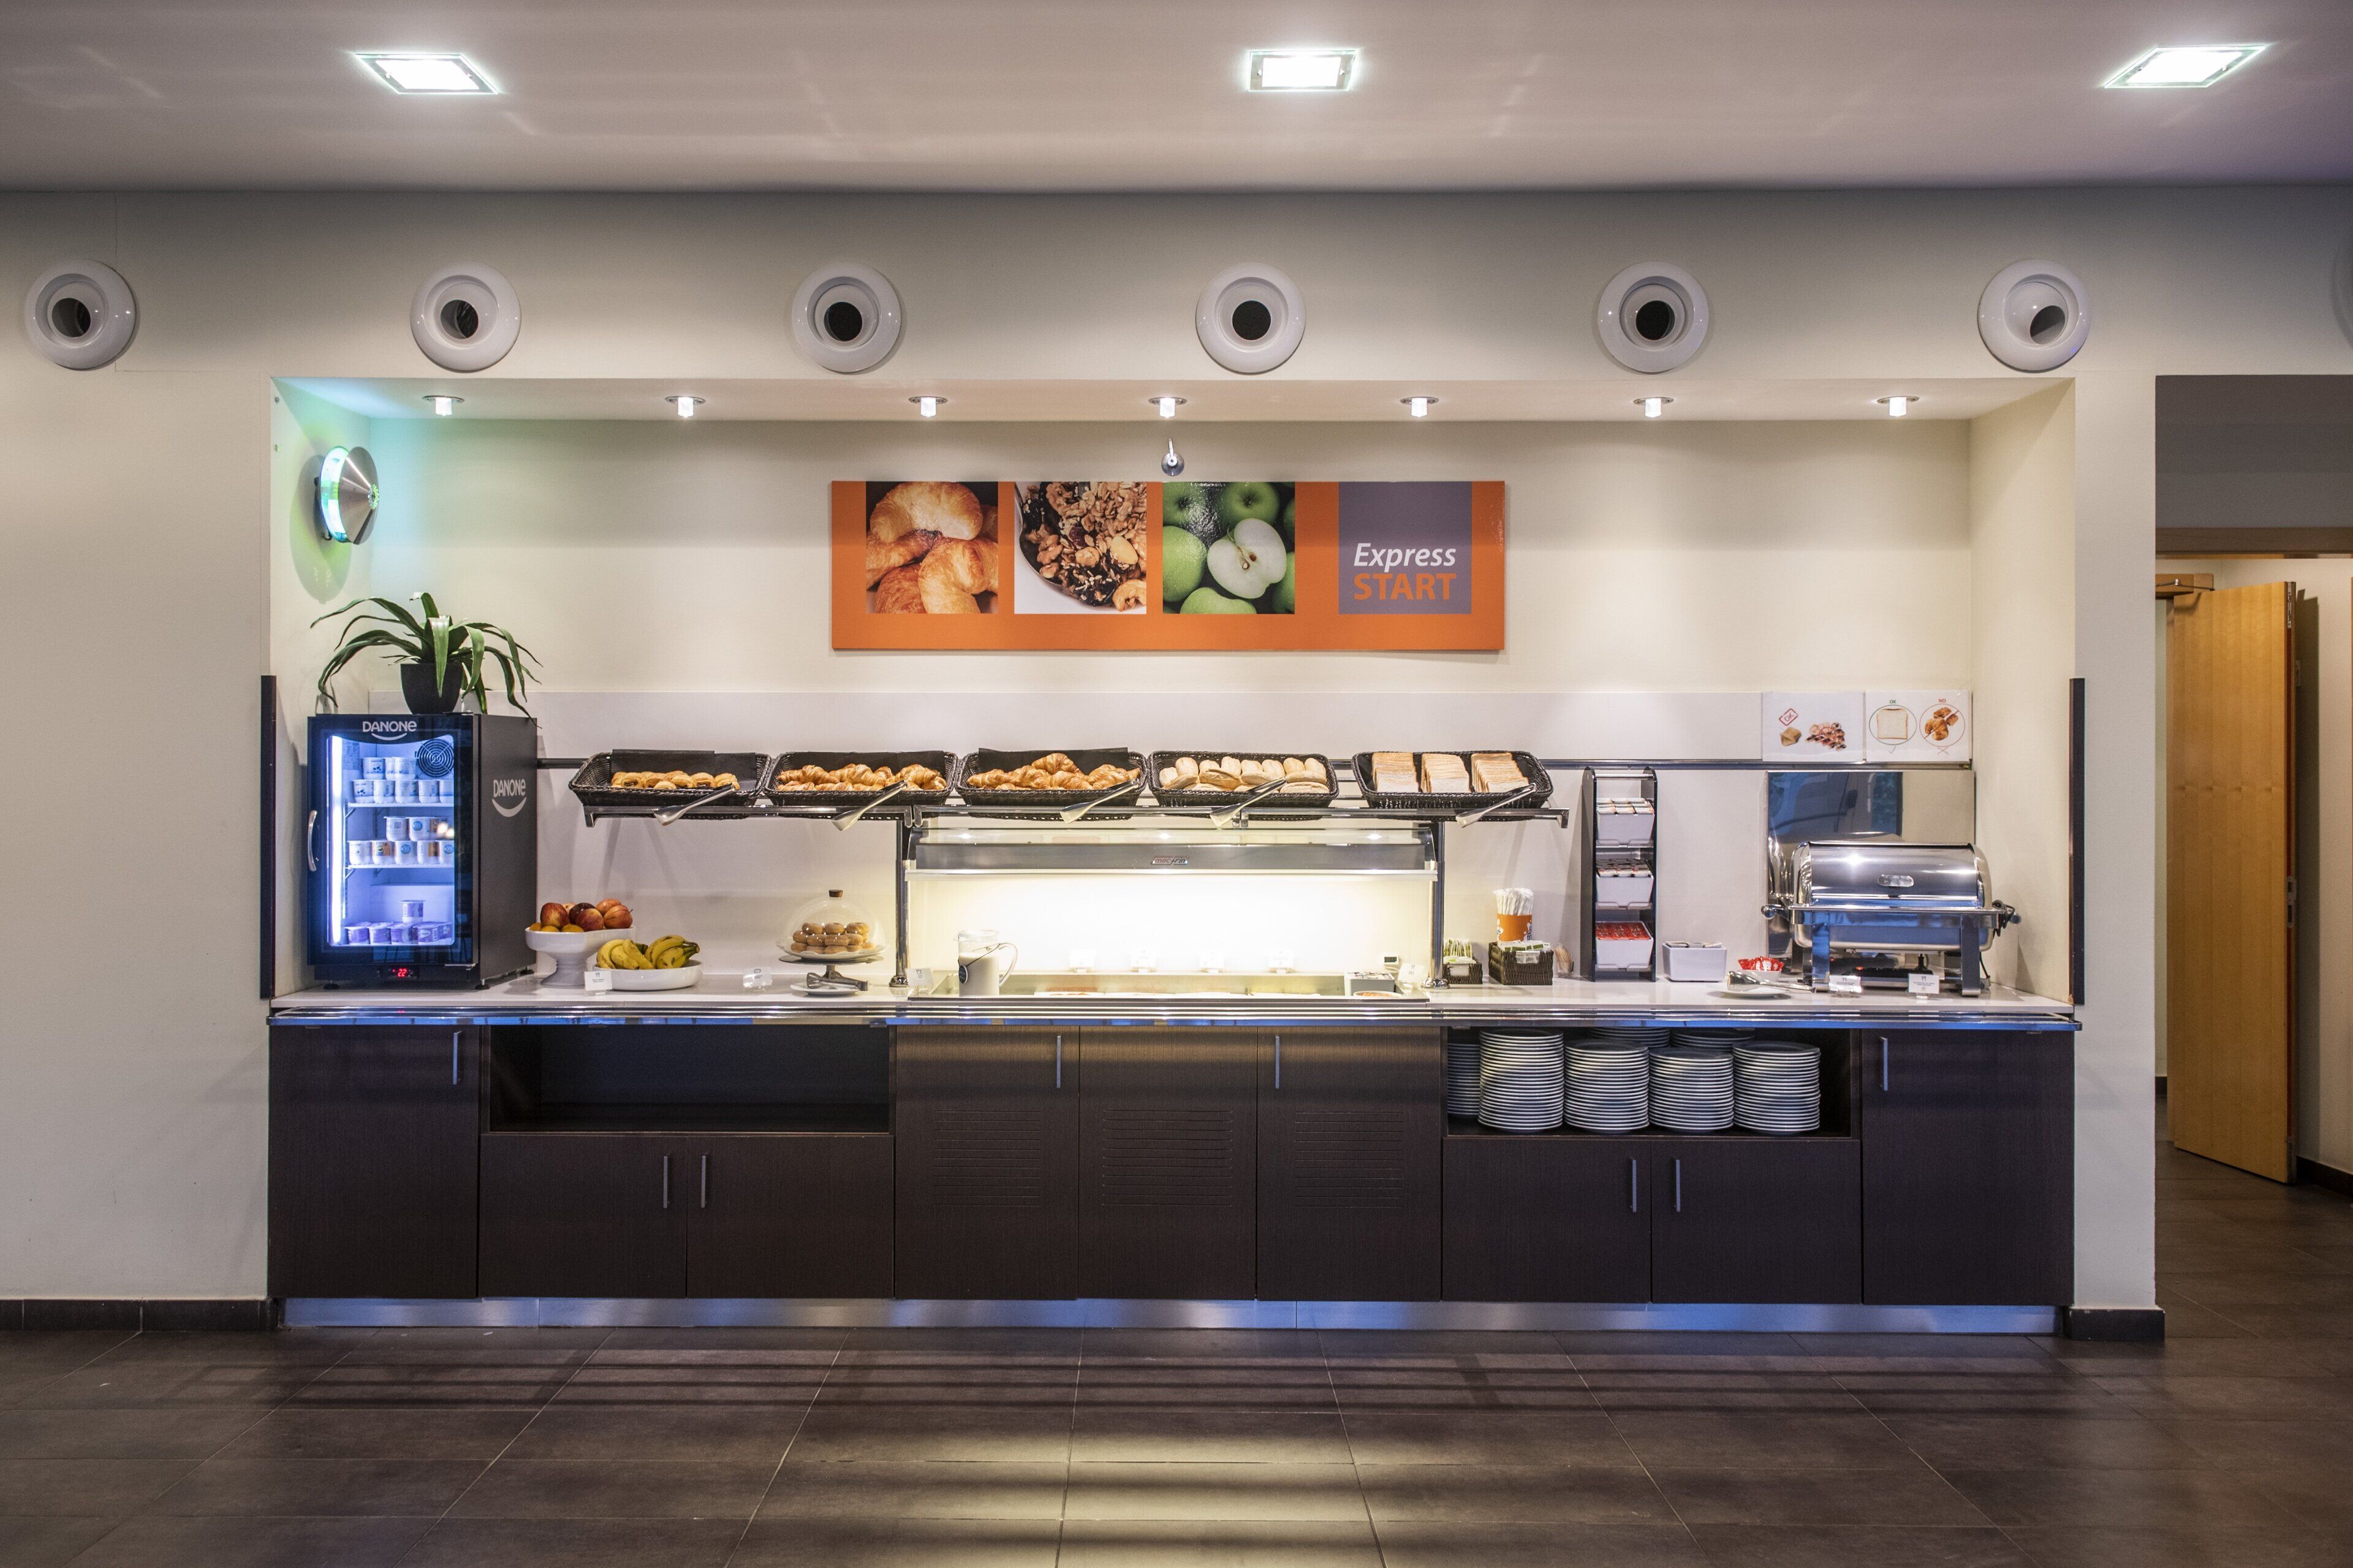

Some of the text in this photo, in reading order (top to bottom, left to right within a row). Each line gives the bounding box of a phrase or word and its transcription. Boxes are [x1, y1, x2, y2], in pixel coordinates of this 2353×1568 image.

[1354, 542, 1457, 573] Express
[1354, 572, 1457, 600] START
[1784, 712, 1795, 722] OK
